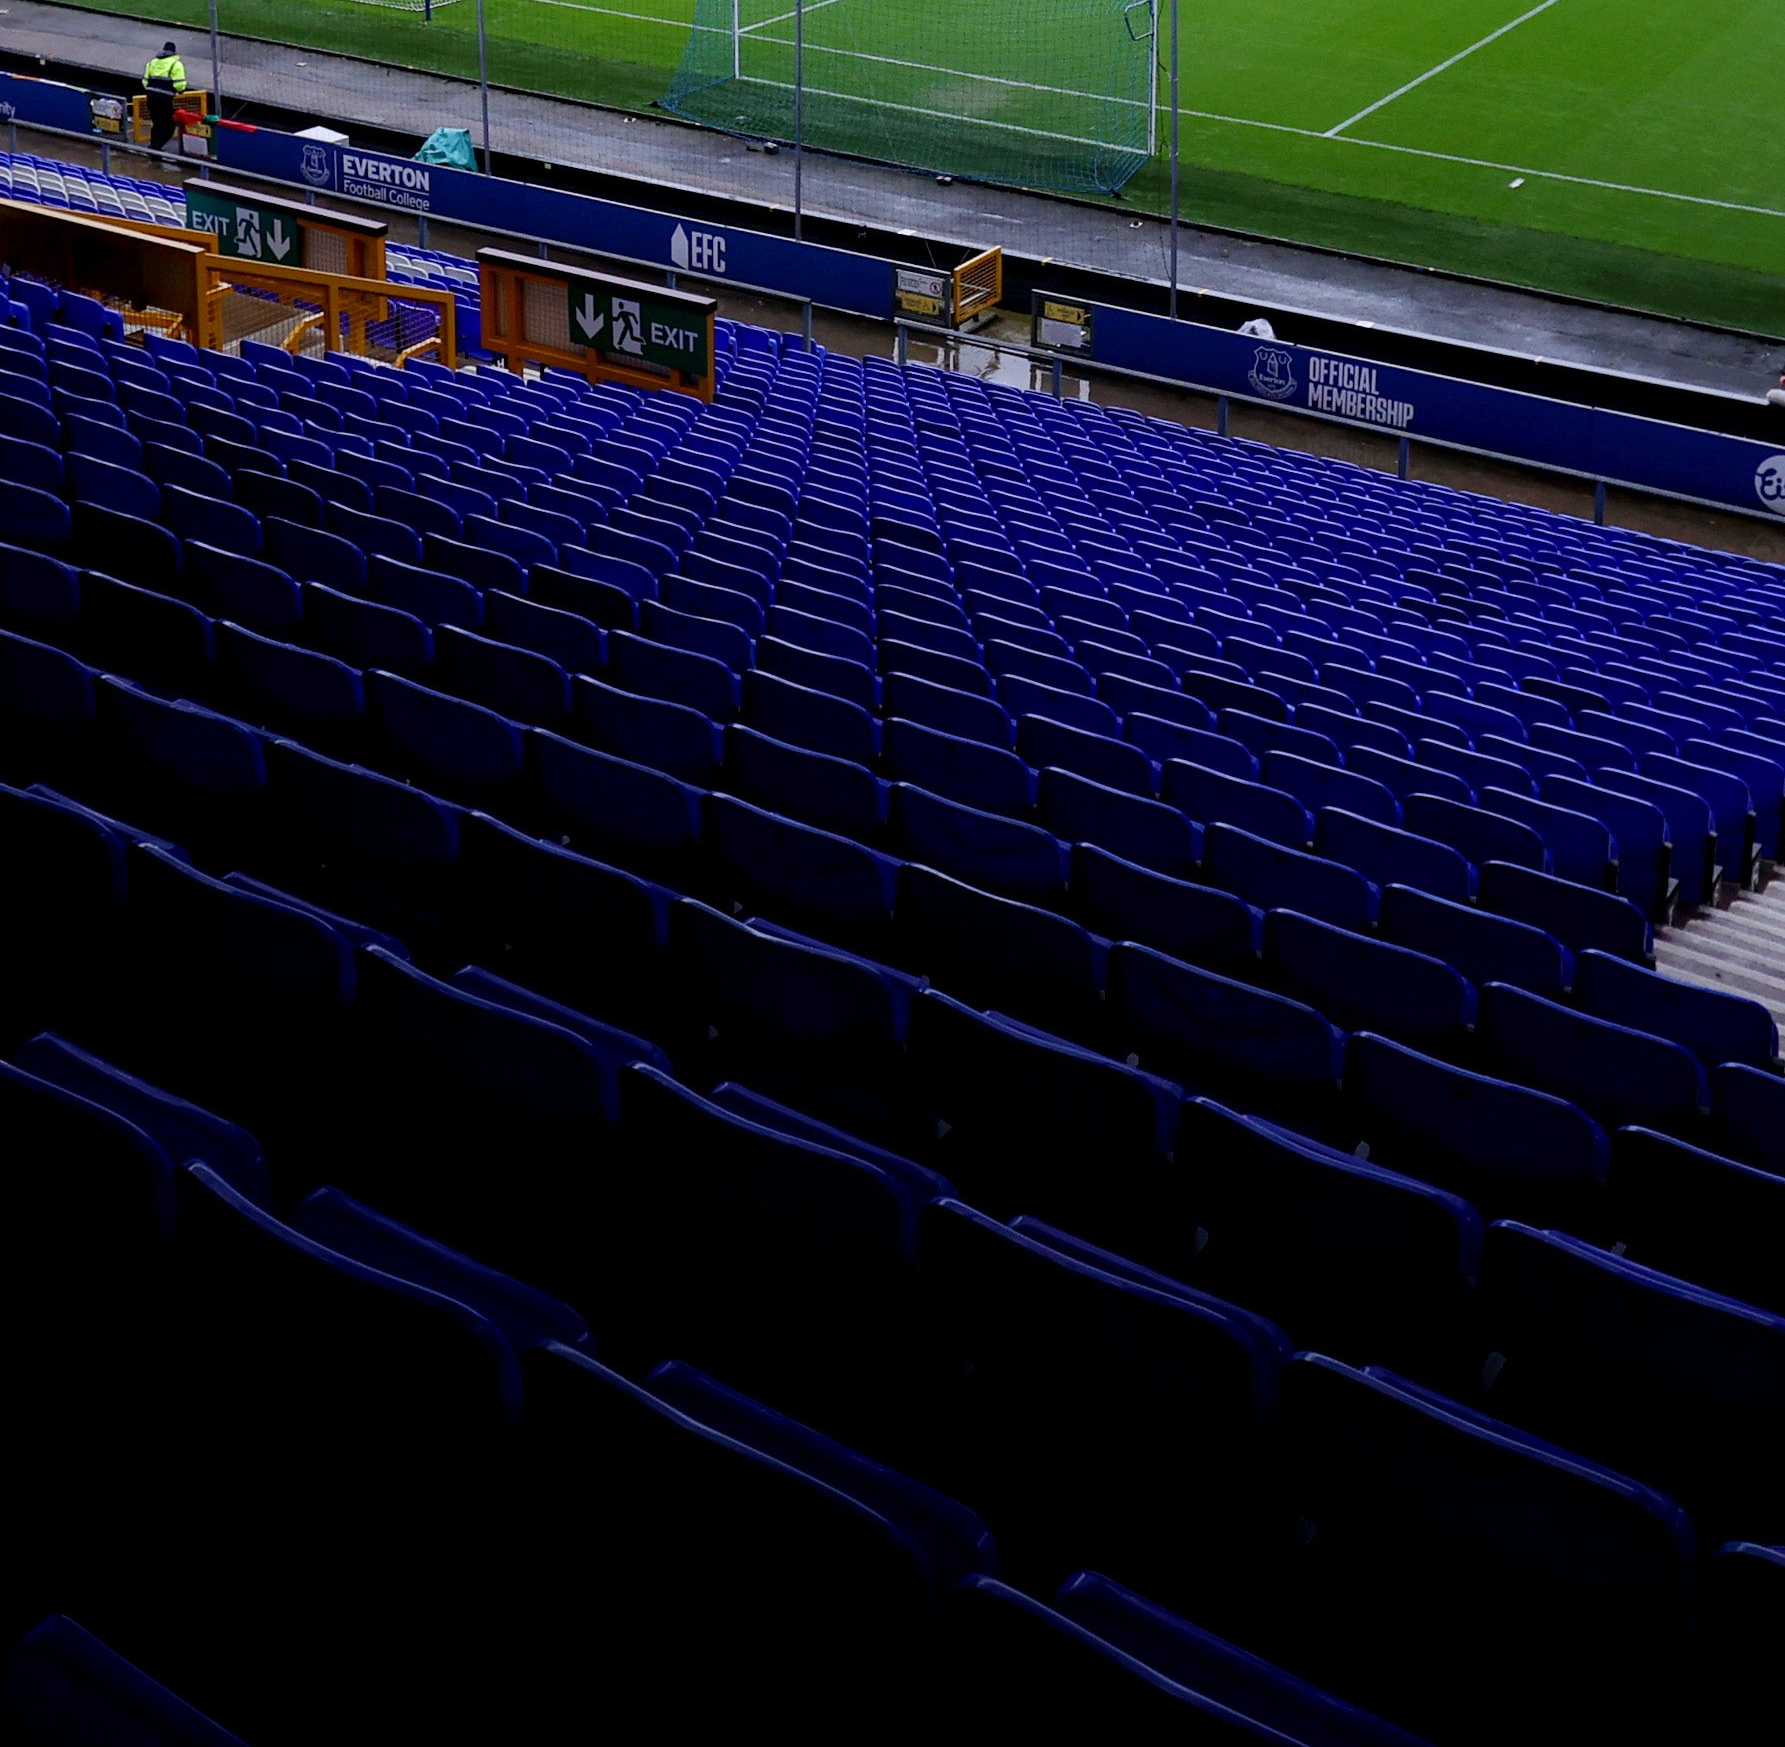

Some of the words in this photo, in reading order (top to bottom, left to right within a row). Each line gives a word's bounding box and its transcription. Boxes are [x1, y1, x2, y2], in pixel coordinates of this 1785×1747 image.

[342, 154, 430, 192] EVERTON
[343, 179, 387, 202] Football
[388, 189, 430, 212] College
[192, 210, 231, 237] EXIT
[691, 230, 727, 274] EFC
[650, 321, 699, 353] EXIT
[1308, 356, 1380, 396] OFFICIAL
[1307, 382, 1415, 429] MEMBERSHIP
